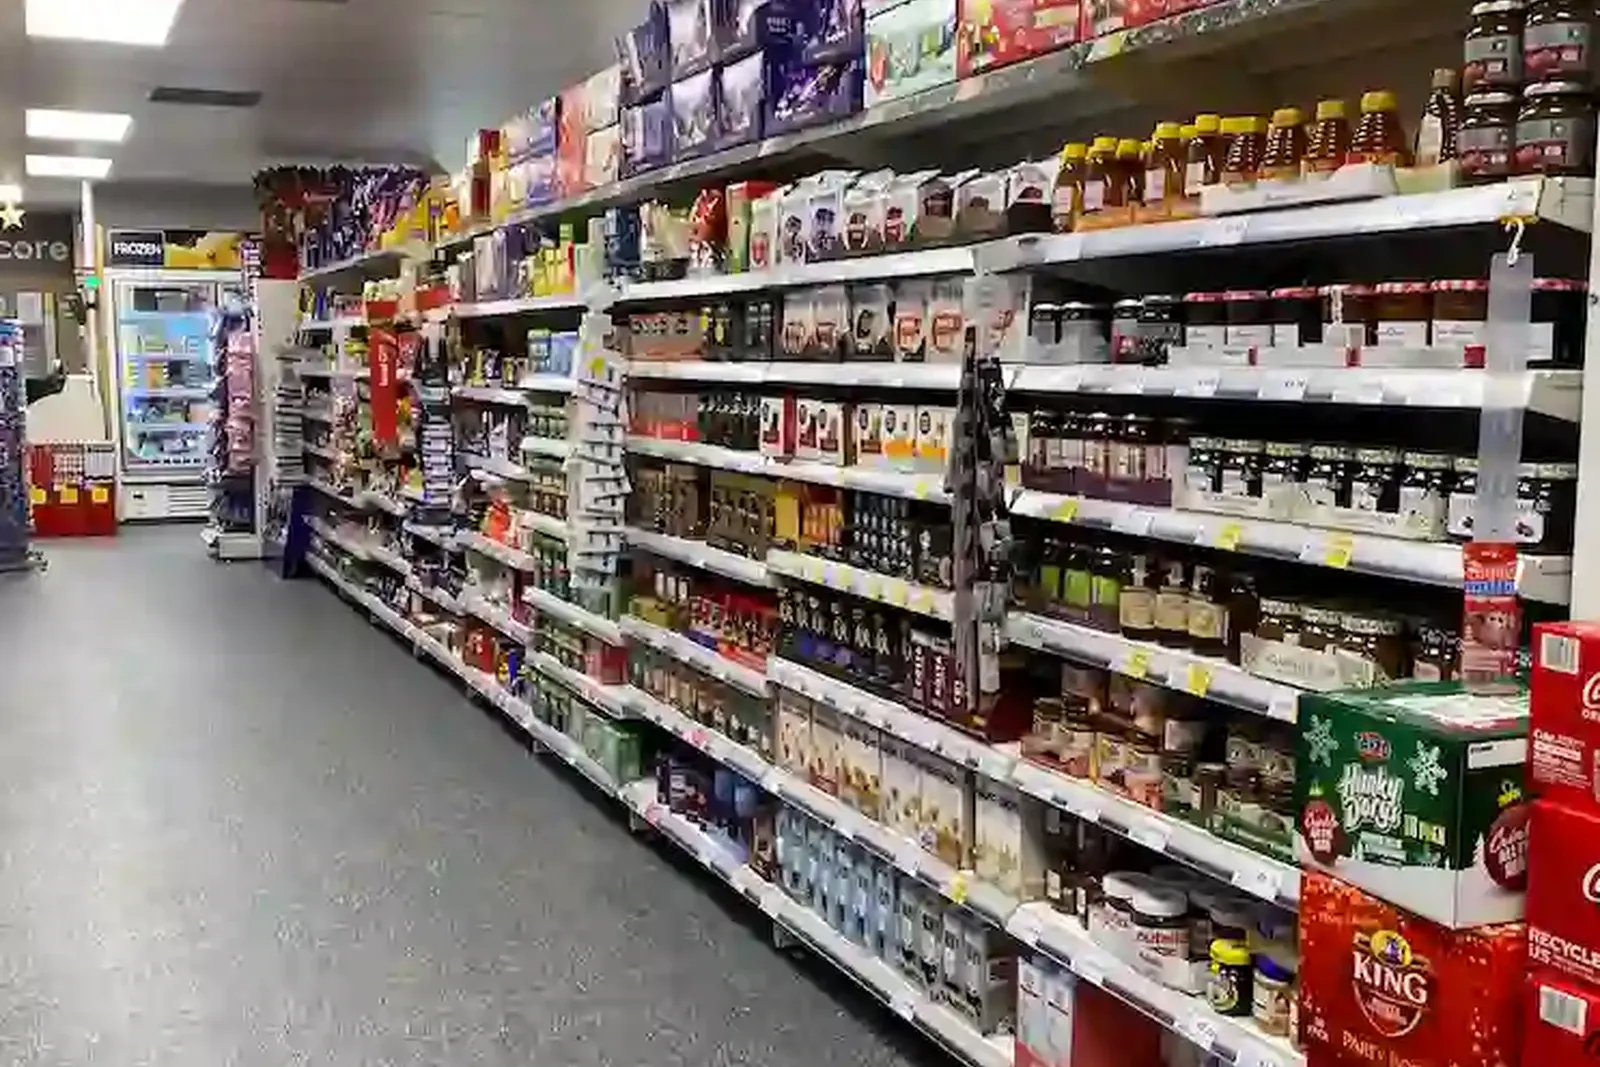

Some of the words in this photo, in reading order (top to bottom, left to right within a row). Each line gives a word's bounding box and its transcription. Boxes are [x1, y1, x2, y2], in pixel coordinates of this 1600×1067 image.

[114, 242, 161, 255] FROZEN
[1528, 926, 1600, 969] RECYCLE
[1352, 951, 1428, 1004] KING
